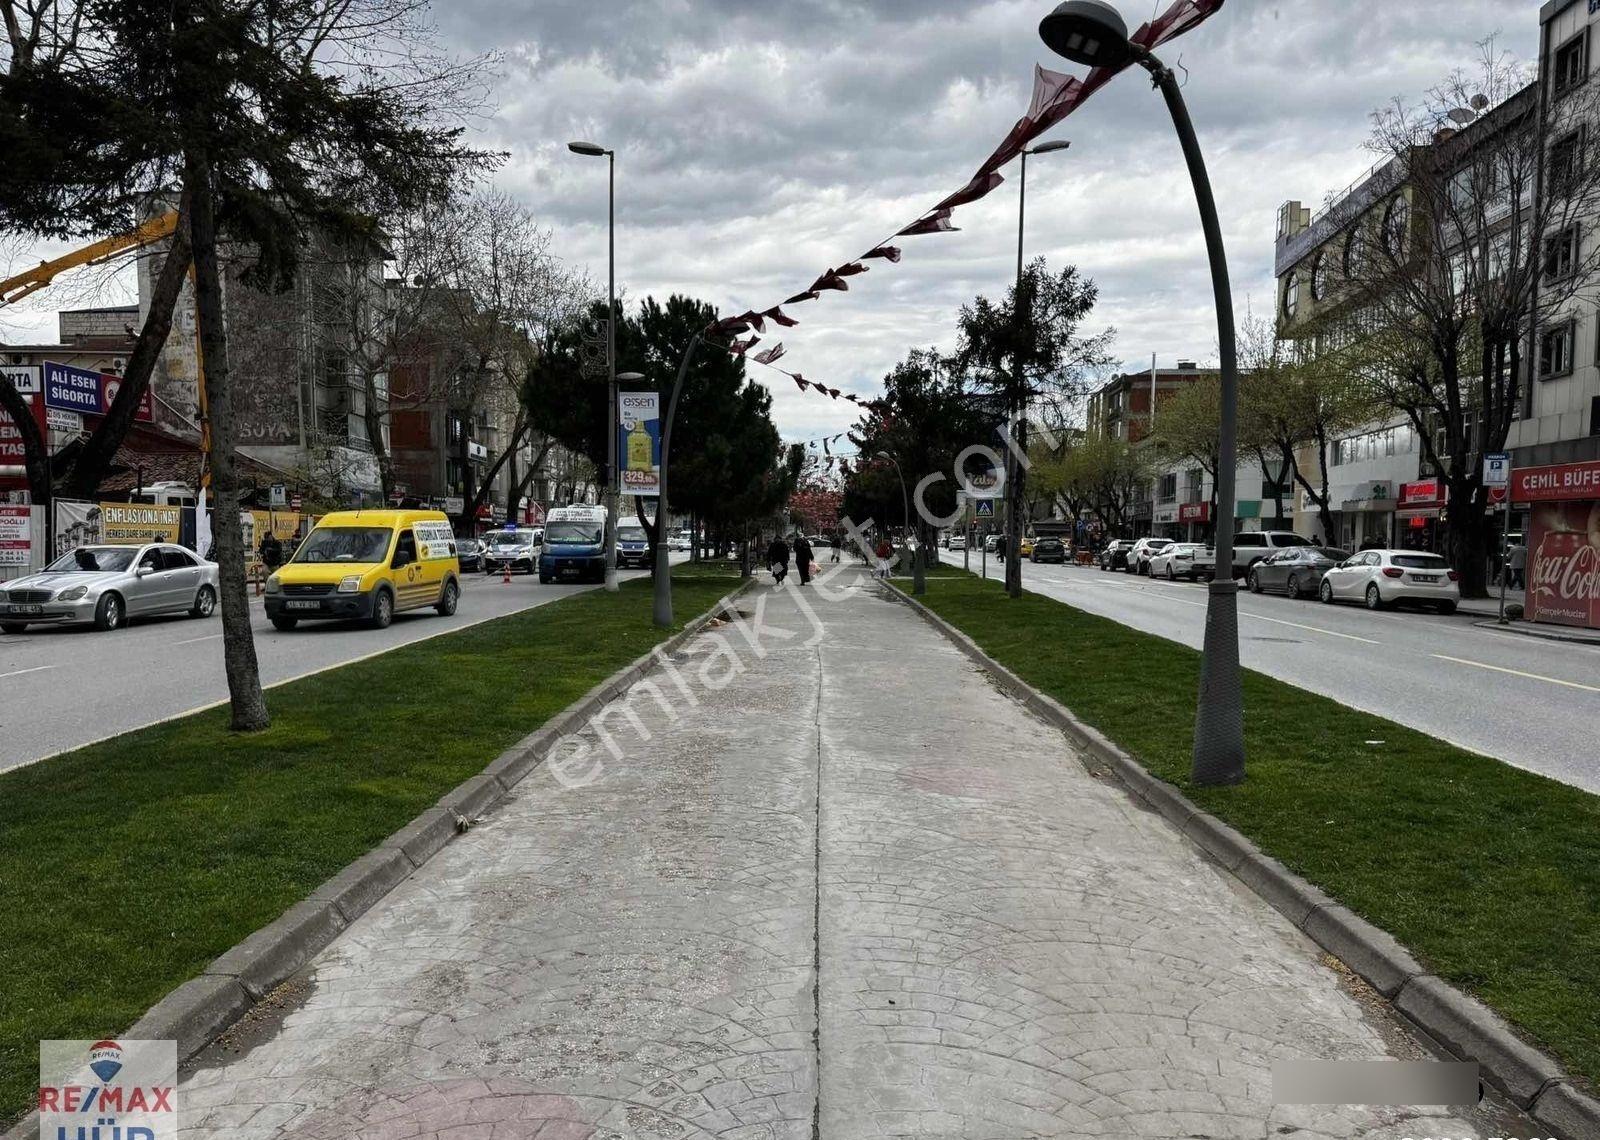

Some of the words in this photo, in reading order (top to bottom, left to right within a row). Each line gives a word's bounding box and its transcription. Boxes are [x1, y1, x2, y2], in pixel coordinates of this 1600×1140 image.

[52, 371, 67, 387] ALİ
[71, 377, 96, 390] ESEN
[52, 387, 96, 406] SİGORTA
[623, 397, 655, 407] essen
[1522, 471, 1560, 490] CEMİL
[1563, 468, 1600, 487] BÜFE
[105, 507, 159, 524] ENFLASYONA
